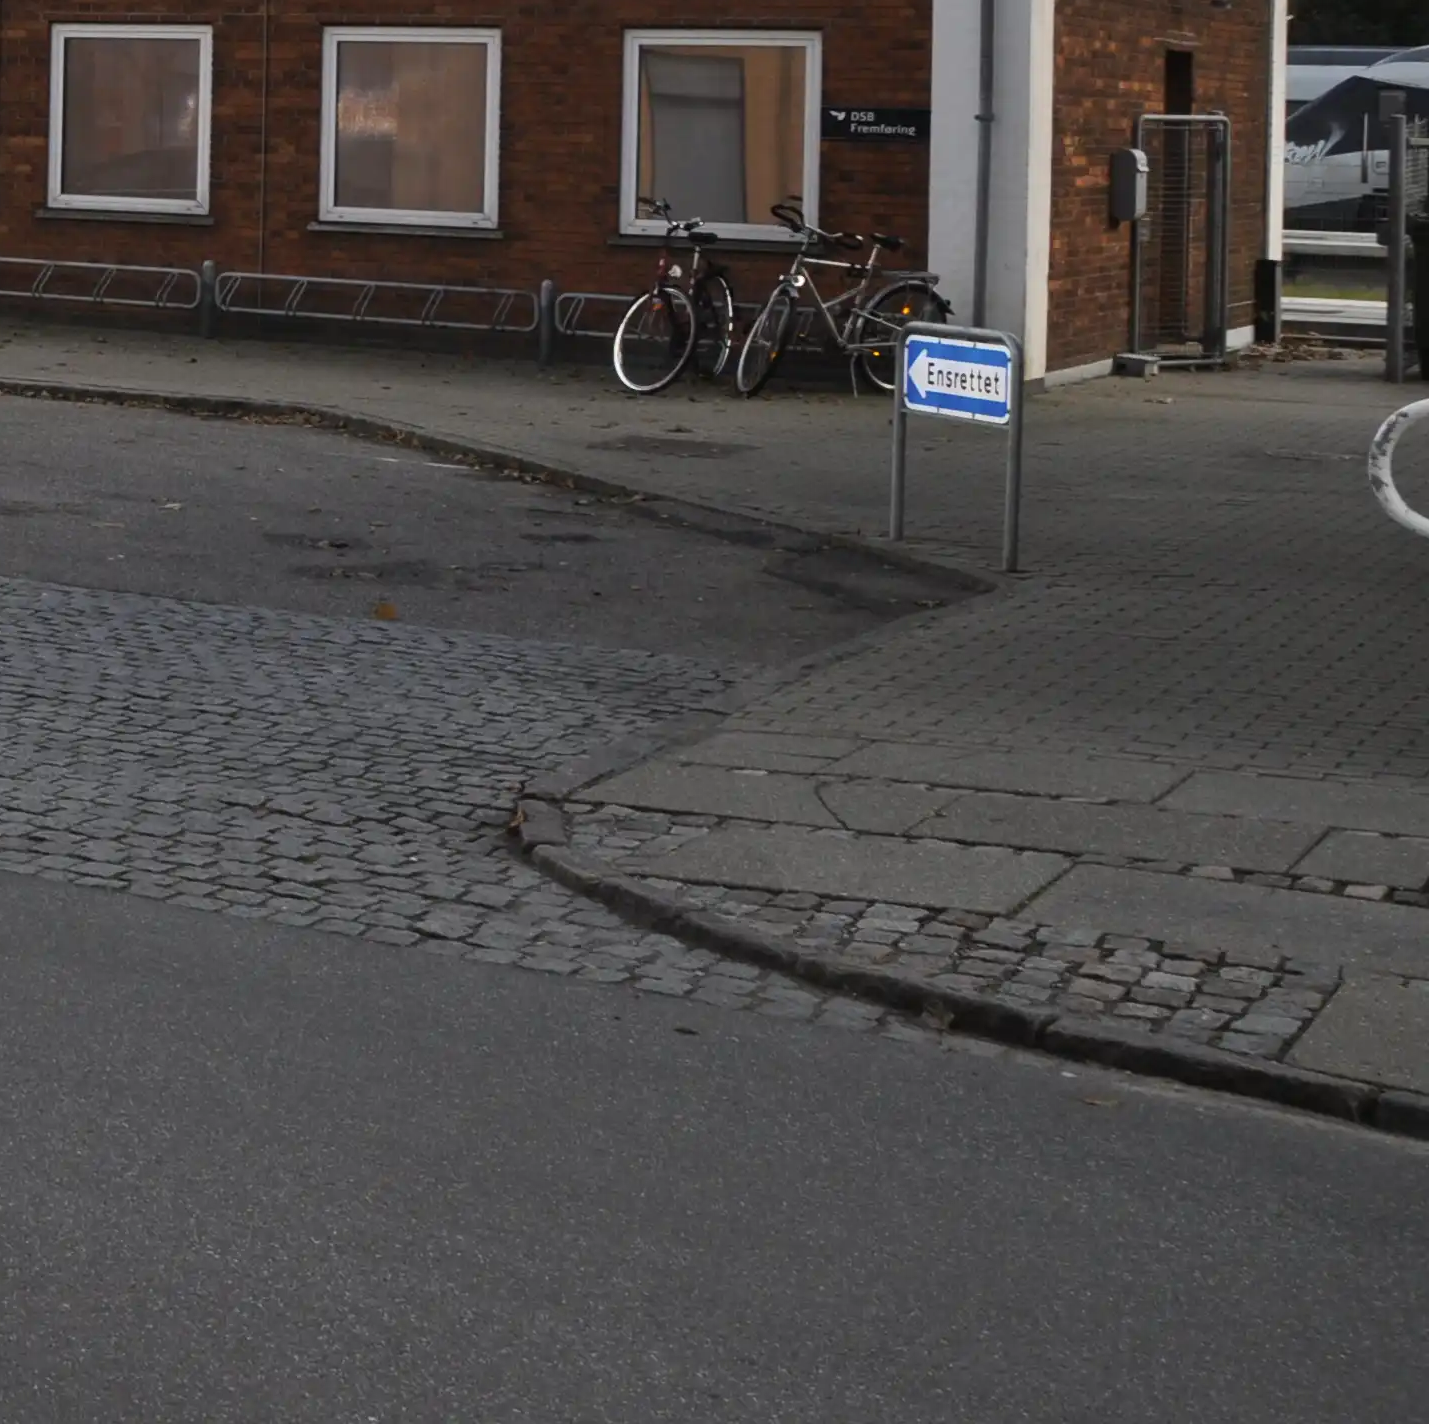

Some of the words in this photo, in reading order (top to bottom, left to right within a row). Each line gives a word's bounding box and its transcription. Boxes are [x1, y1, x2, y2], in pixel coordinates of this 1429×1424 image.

[850, 111, 875, 122] DSB
[849, 122, 916, 136] Fremføring
[927, 362, 1000, 396] Ensrettet
